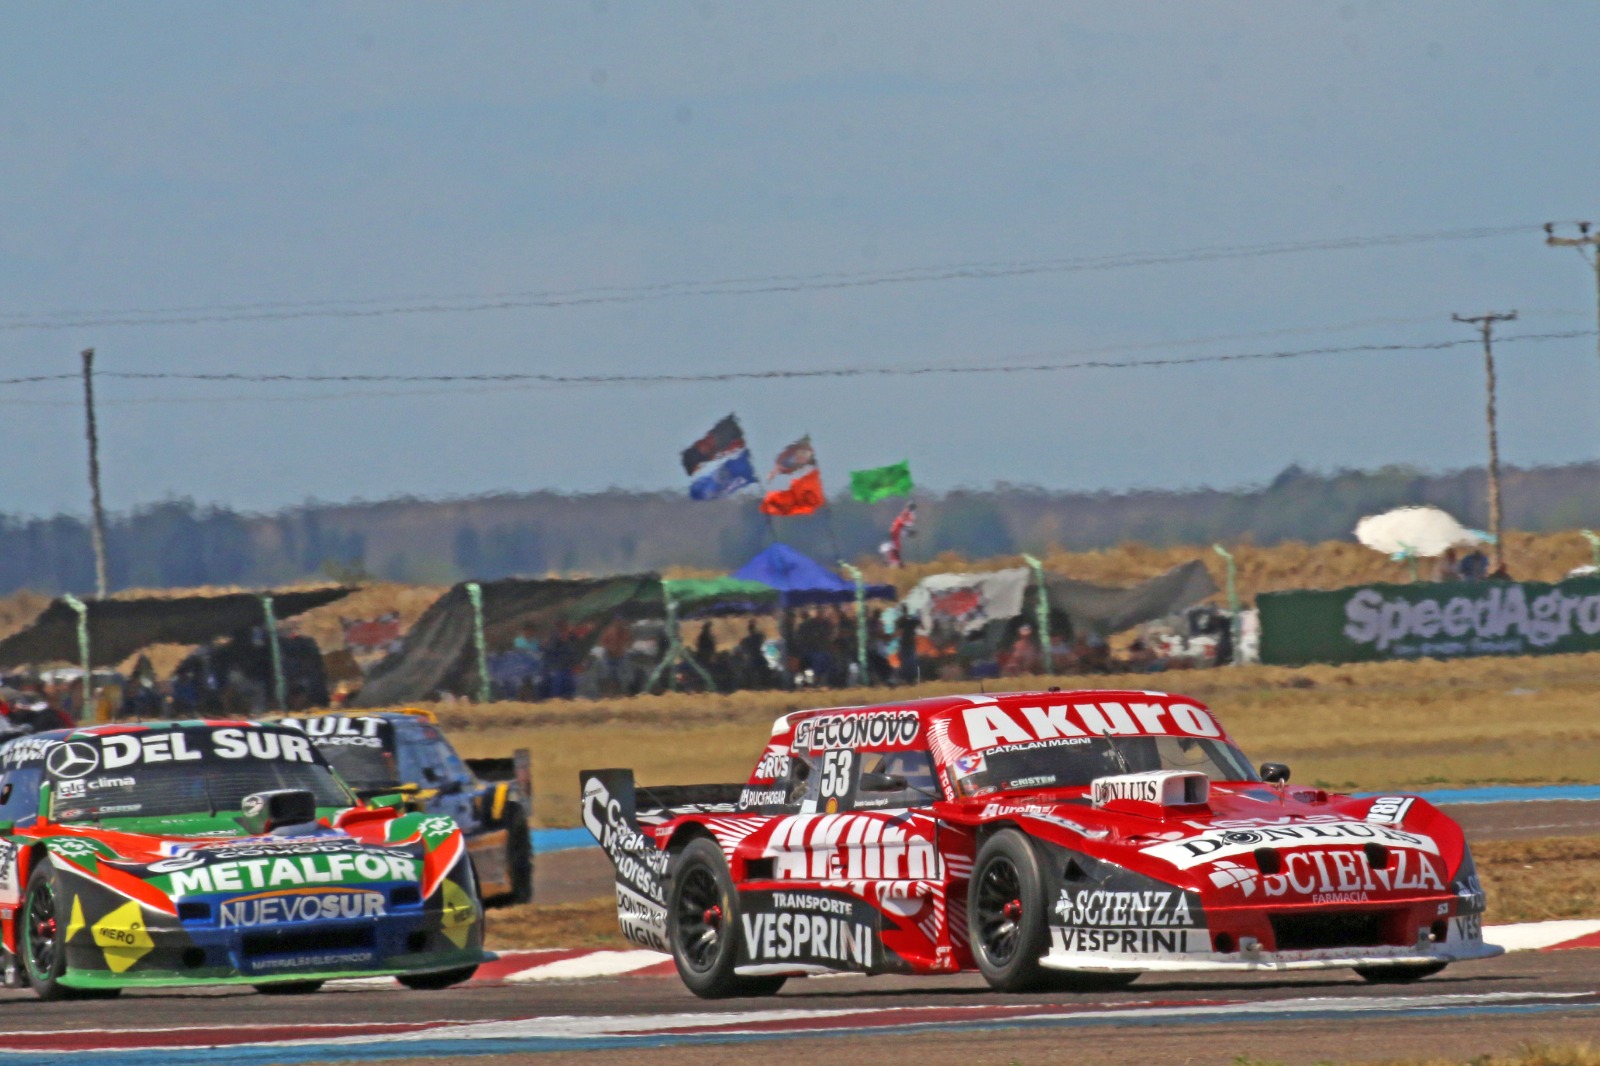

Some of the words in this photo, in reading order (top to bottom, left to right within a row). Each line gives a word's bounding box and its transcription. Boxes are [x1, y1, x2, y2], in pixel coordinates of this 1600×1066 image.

[1344, 585, 1600, 651] SpeedAgro
[812, 713, 919, 747] ECONOVO
[986, 741, 1048, 757] CATALAN
[1049, 737, 1091, 748] MAGNI
[101, 731, 202, 769] DEL
[212, 729, 314, 763] SUR
[765, 756, 790, 778] RUS
[88, 777, 136, 789] clima
[821, 749, 852, 797] 53
[169, 854, 418, 900] METALFOR
[1263, 849, 1446, 897] SCIENZA
[773, 893, 852, 916] TRANSPORTE
[1073, 889, 1194, 926] SCIENZA
[742, 914, 872, 968] VESPRINI
[1060, 928, 1187, 953] VESPRINI
